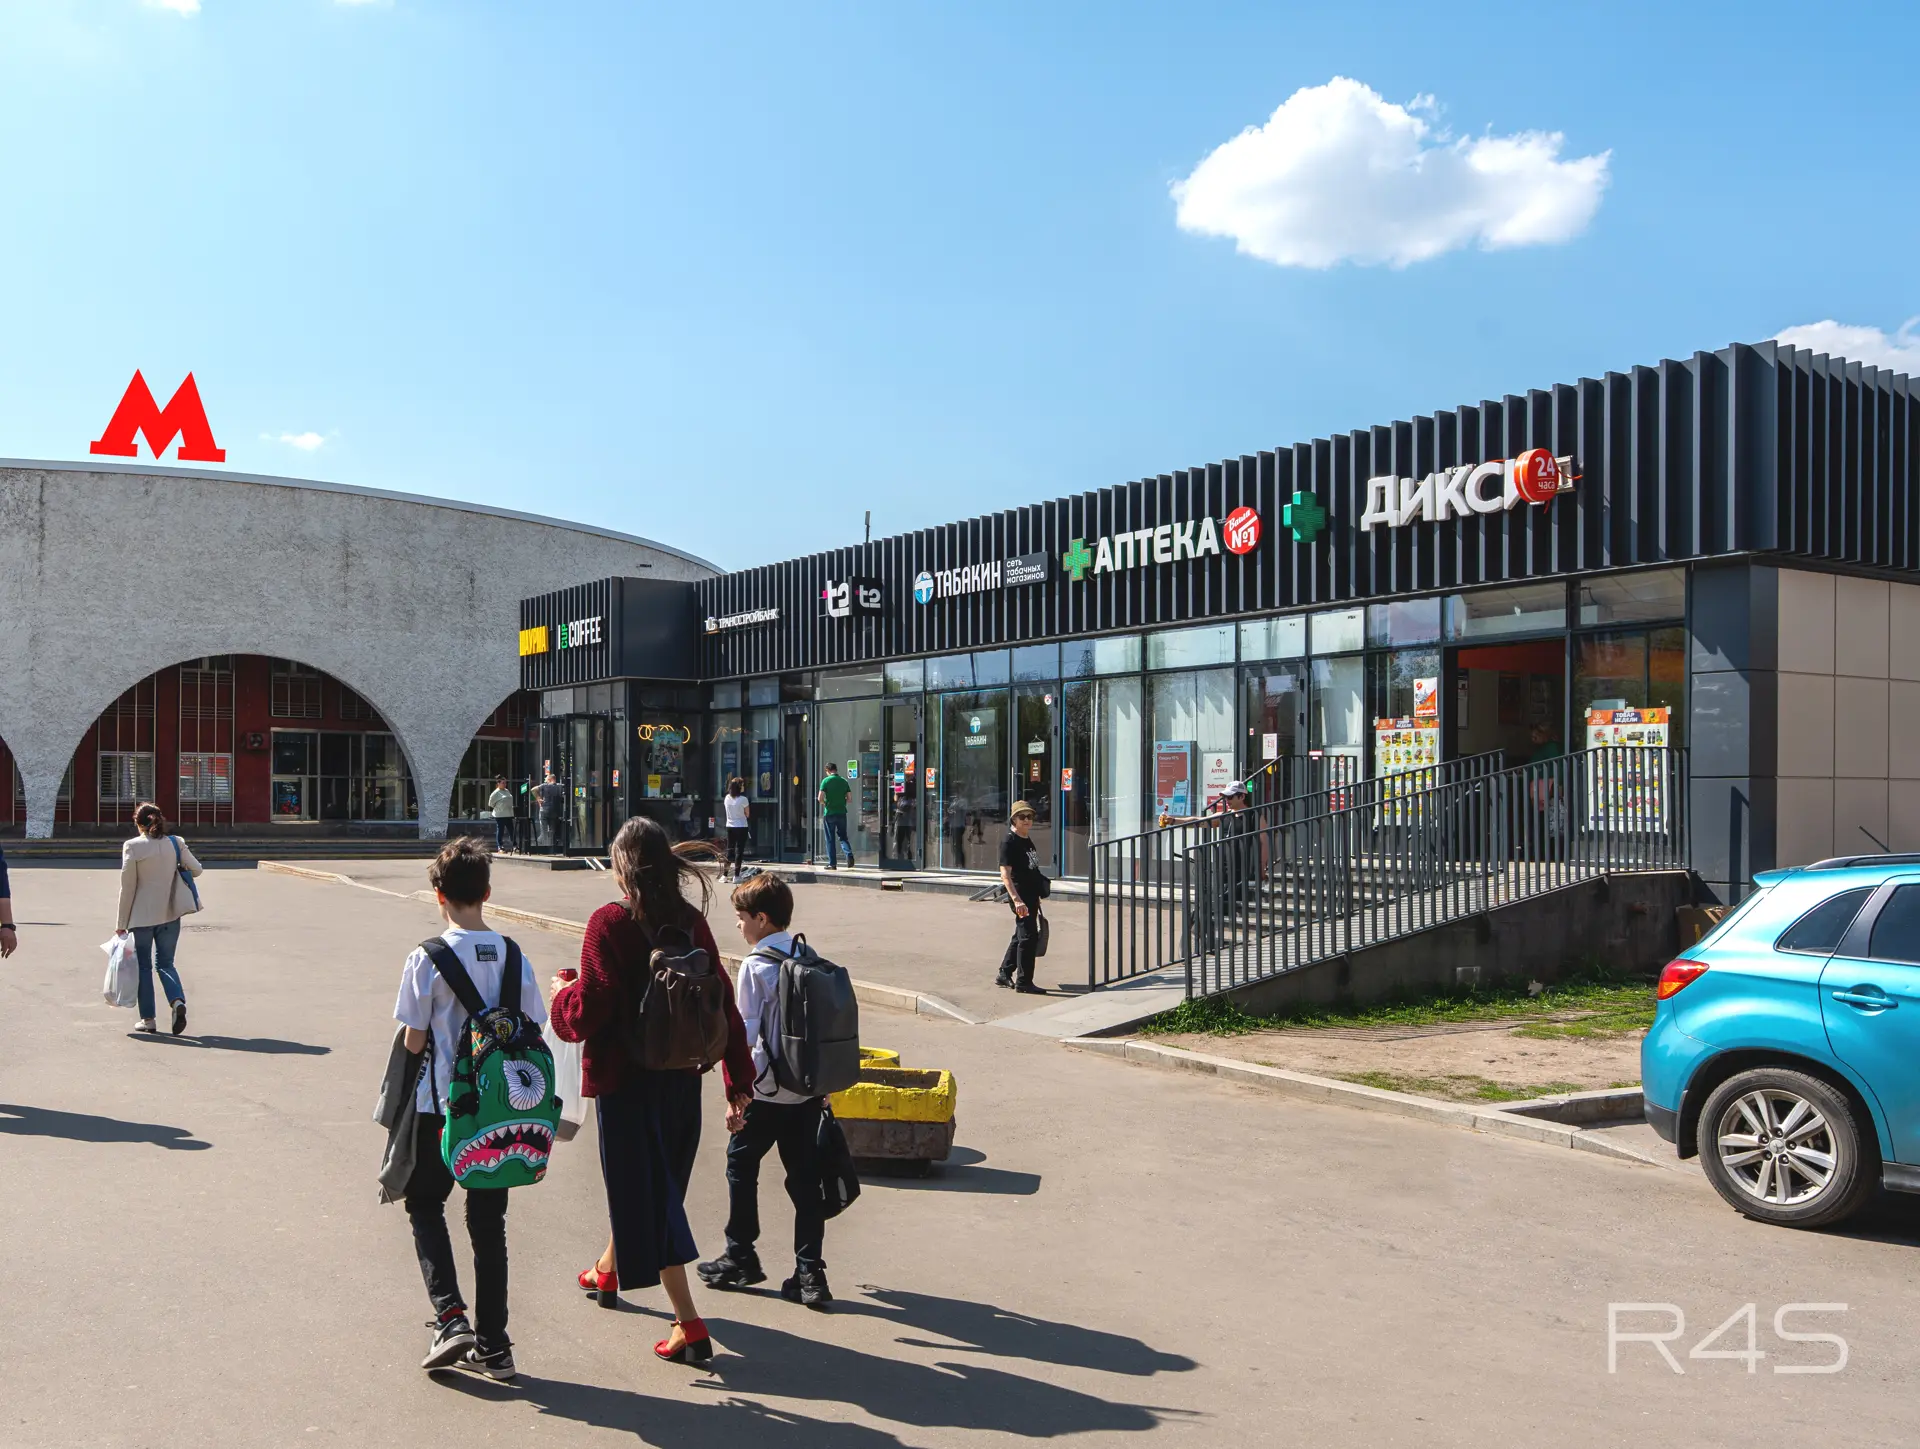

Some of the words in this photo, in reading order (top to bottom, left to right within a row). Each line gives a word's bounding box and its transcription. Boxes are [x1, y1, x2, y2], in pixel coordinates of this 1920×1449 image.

[90, 369, 226, 462] М
[1534, 456, 1556, 477] 24
[1537, 481, 1556, 490] часа
[1228, 509, 1251, 532] Ваша
[1094, 517, 1220, 574] АПТЕКА
[1006, 559, 1022, 568] сеть
[1006, 564, 1042, 577] табачных
[935, 560, 1001, 598] ТАБАКИН
[1006, 571, 1045, 584] магазинов
[823, 580, 850, 618] t2
[855, 585, 881, 609] t2
[719, 608, 780, 629] ТРАНССТРОЙБАНК
[568, 616, 602, 648] COFFEE
